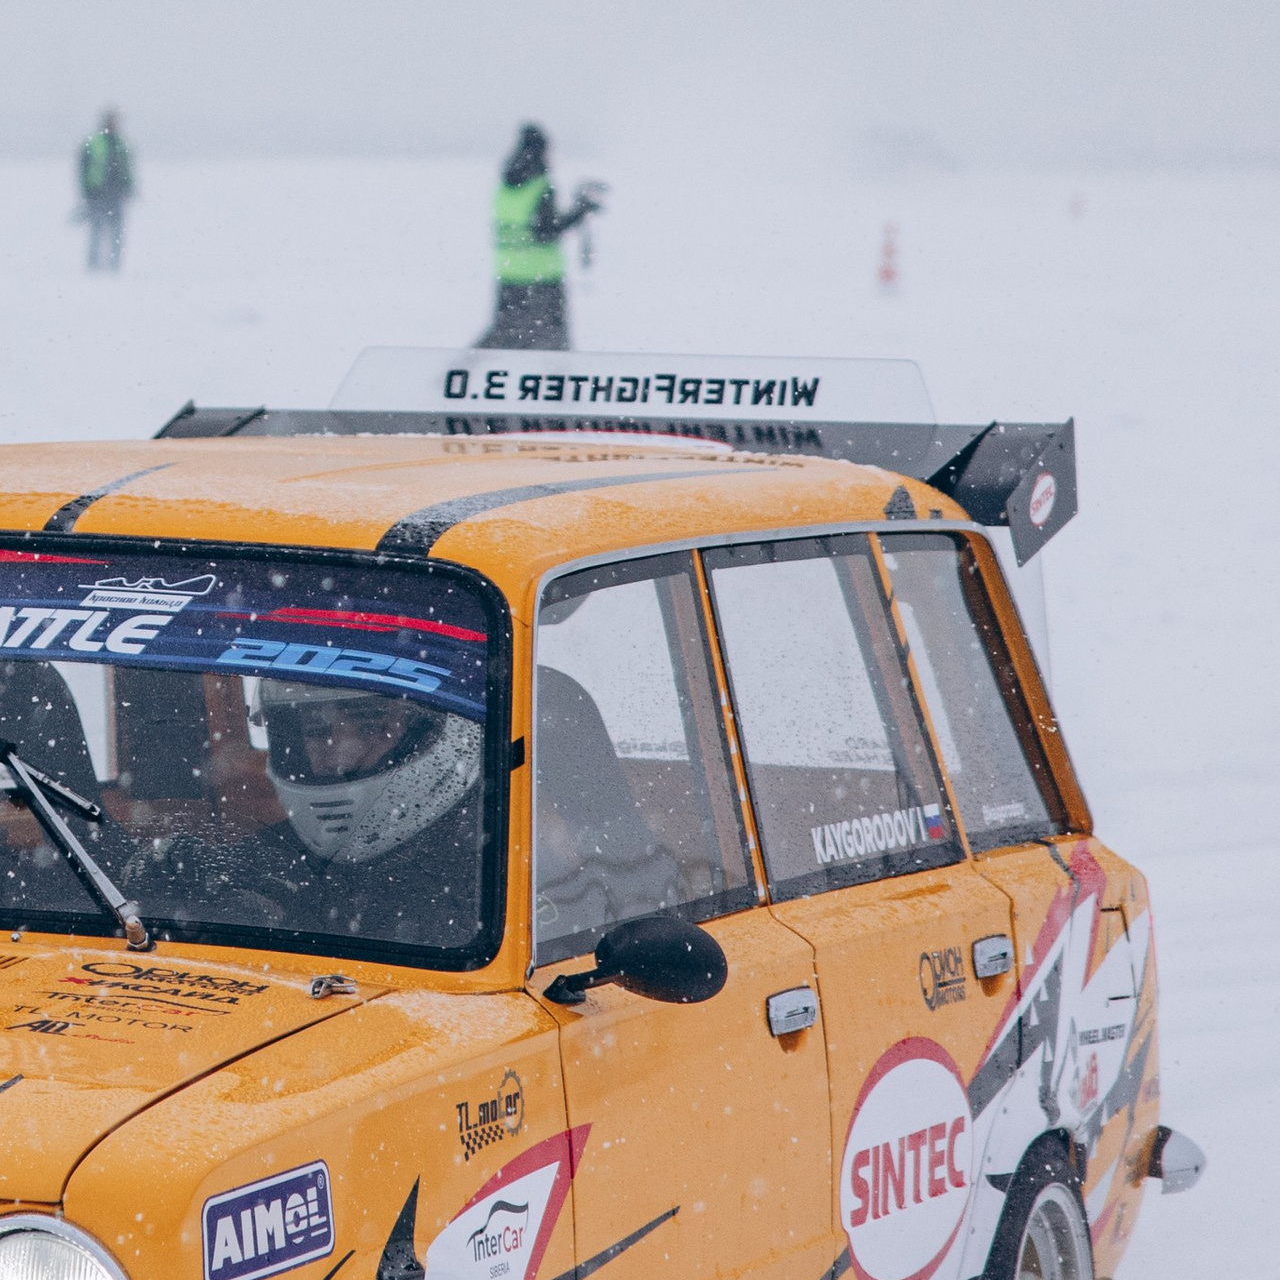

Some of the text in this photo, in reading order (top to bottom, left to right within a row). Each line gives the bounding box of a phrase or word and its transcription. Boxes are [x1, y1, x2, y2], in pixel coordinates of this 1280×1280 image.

[215, 636, 455, 694] 2025
[811, 807, 916, 864] KAYGORODOV
[79, 1003, 142, 1015] SIBERIA
[850, 1115, 967, 1228] SINTEC
[489, 1261, 511, 1280] SIBERIA
